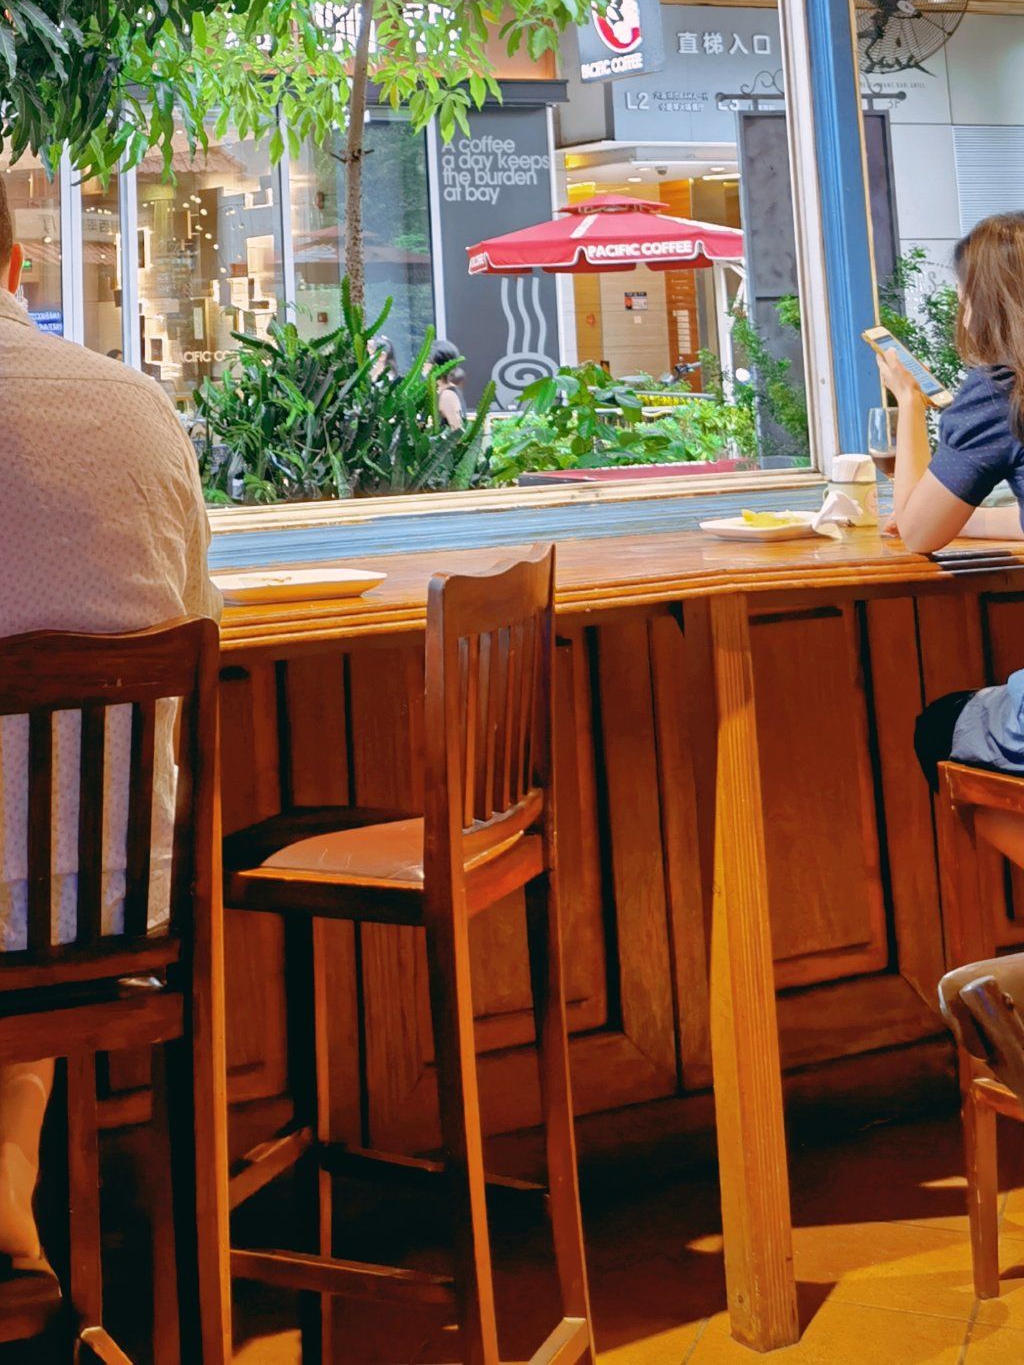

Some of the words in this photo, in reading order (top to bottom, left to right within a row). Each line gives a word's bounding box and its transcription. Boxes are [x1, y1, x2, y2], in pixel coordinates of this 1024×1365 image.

[677, 32, 772, 55] 直梯入口
[626, 91, 650, 110] L2
[458, 135, 516, 153] coffee
[442, 154, 455, 169] a
[458, 149, 494, 172] day
[498, 151, 551, 173] keeps
[443, 167, 471, 185] the
[475, 168, 538, 185] burden
[443, 183, 462, 201] at
[465, 184, 500, 205] bay
[587, 243, 641, 257] PACIFIC
[641, 240, 694, 256] COFFEE
